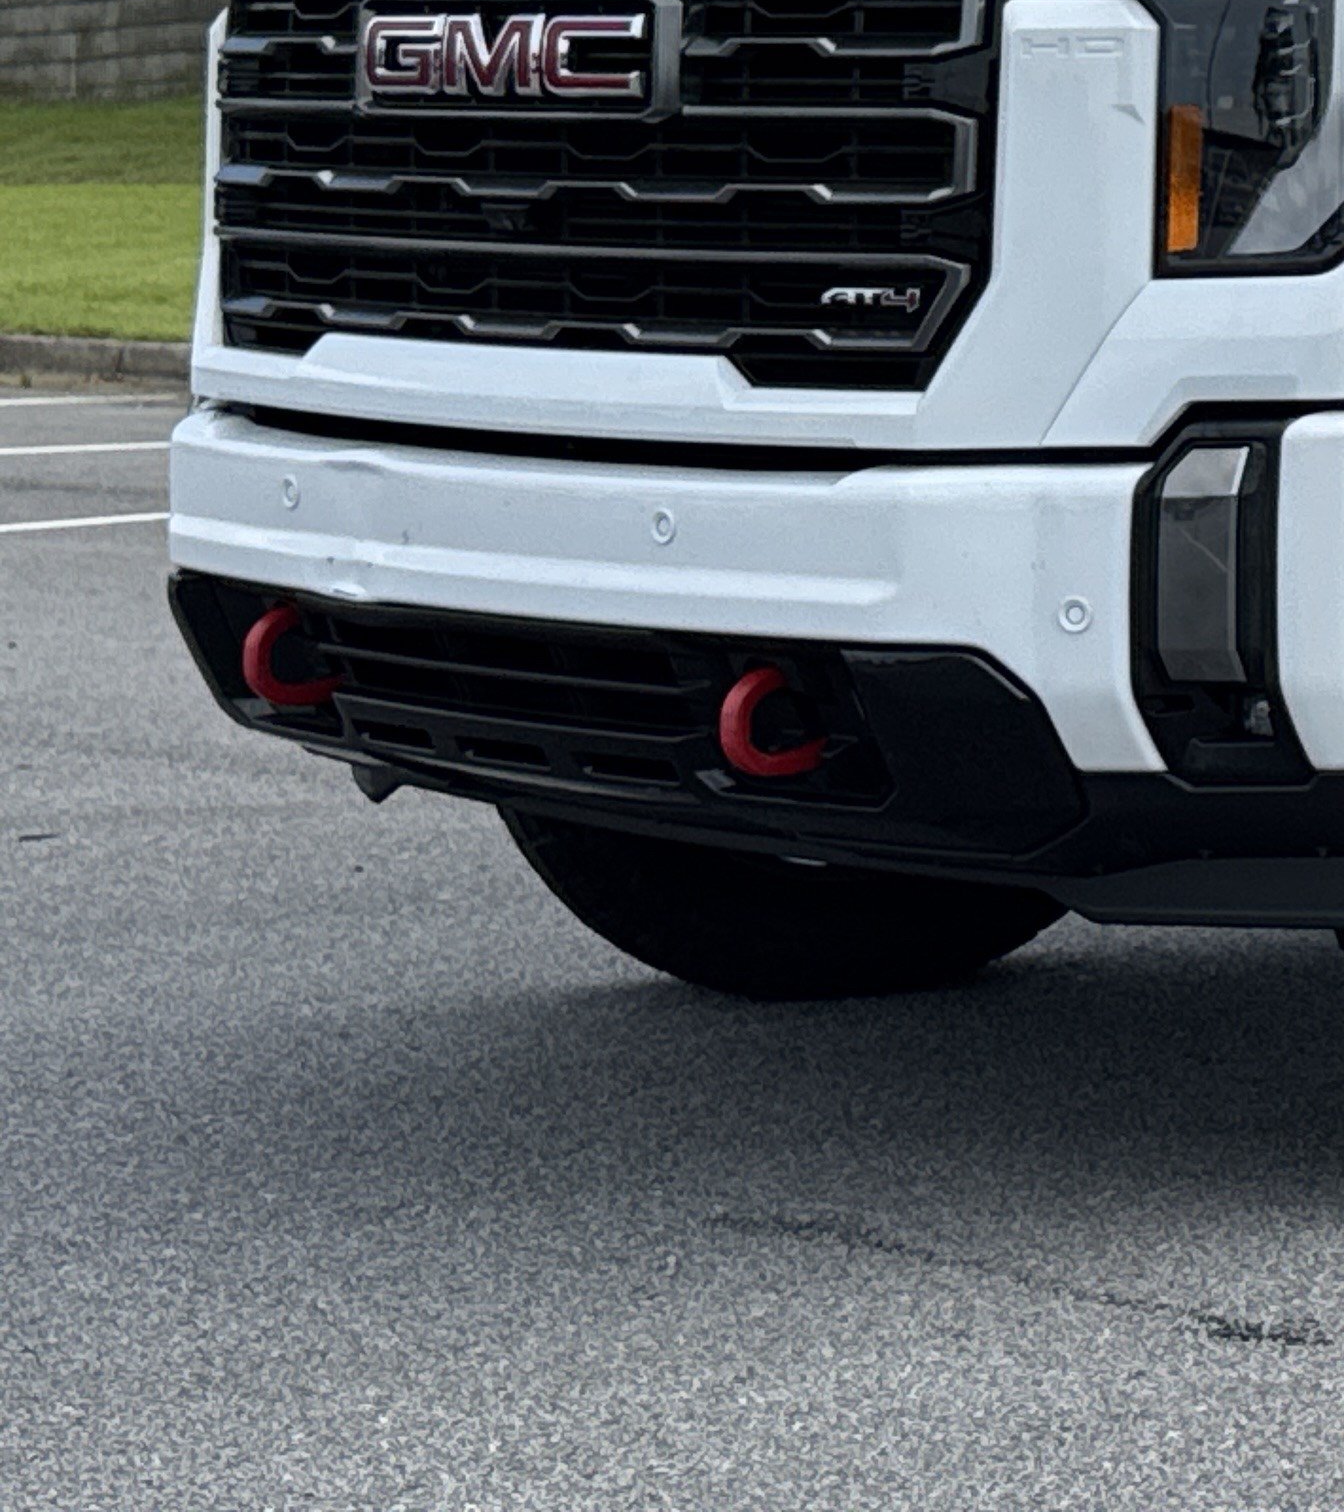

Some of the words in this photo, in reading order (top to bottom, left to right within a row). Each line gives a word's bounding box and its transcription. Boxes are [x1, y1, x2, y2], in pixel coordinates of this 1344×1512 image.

[366, 13, 646, 98] GMC
[1021, 37, 1125, 59] HD
[820, 287, 922, 314] AT4
